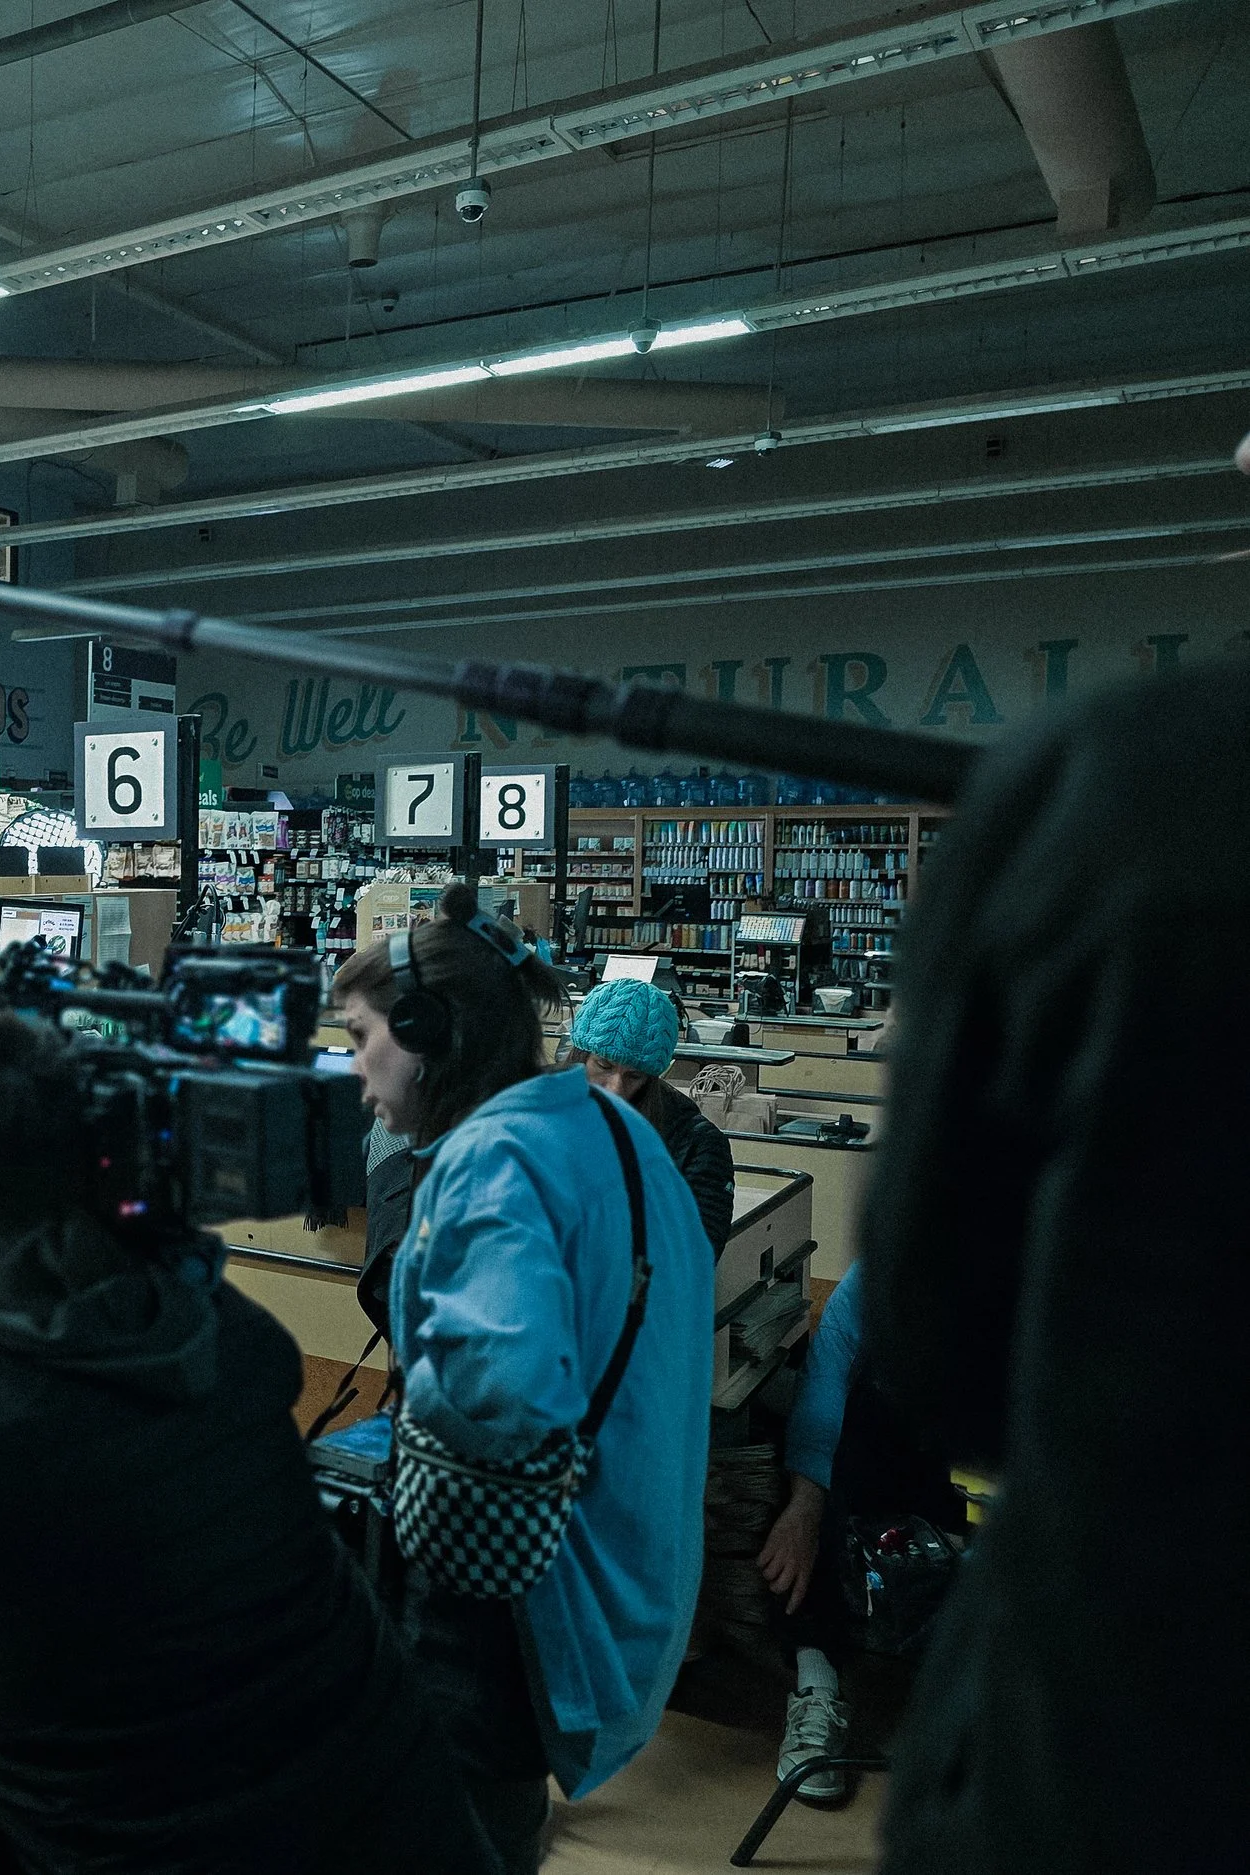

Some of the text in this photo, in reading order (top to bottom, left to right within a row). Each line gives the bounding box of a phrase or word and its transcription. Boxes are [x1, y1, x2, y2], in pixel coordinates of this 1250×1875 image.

[102, 646, 112, 672] 8
[107, 746, 143, 815] 6
[407, 774, 435, 825] 7
[497, 783, 527, 830] 8
